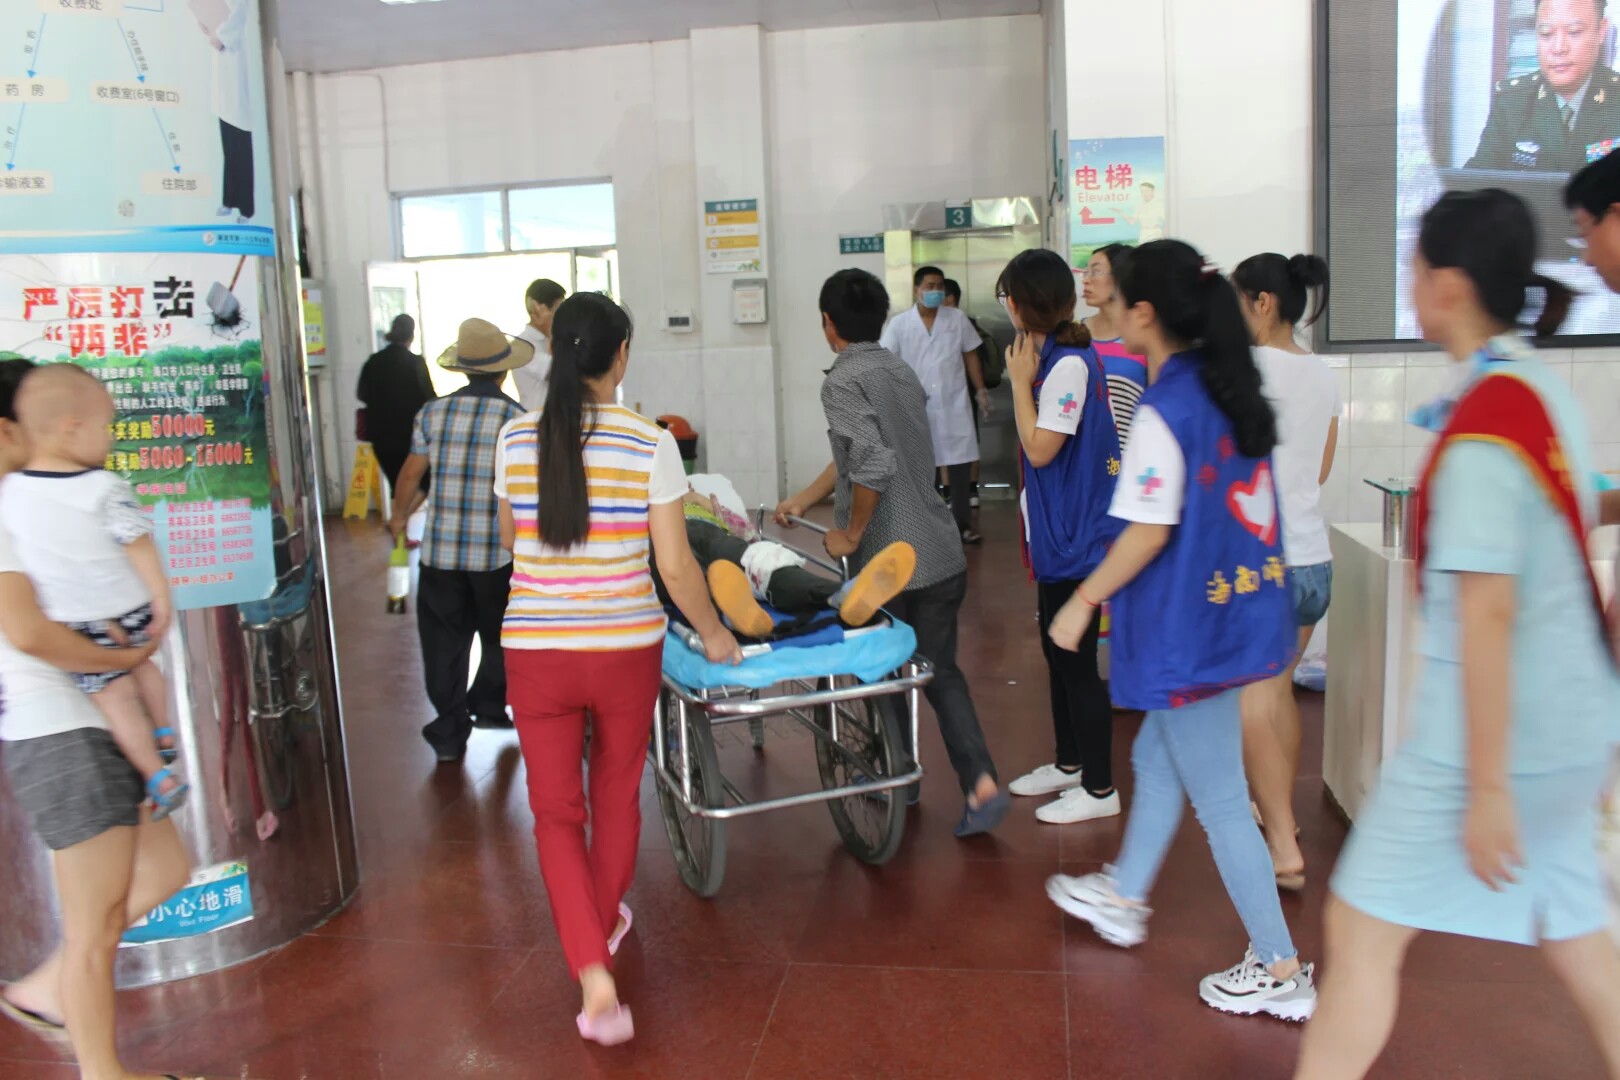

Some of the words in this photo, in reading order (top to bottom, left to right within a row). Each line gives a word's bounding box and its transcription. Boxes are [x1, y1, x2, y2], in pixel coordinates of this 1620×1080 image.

[162, 178, 197, 191] 住院部
[1075, 164, 1133, 190] 电梯
[1078, 192, 1130, 203] Elevator
[952, 209, 965, 225] 3
[23, 276, 195, 321] 严厉打击
[150, 884, 244, 922] 小心地滑
